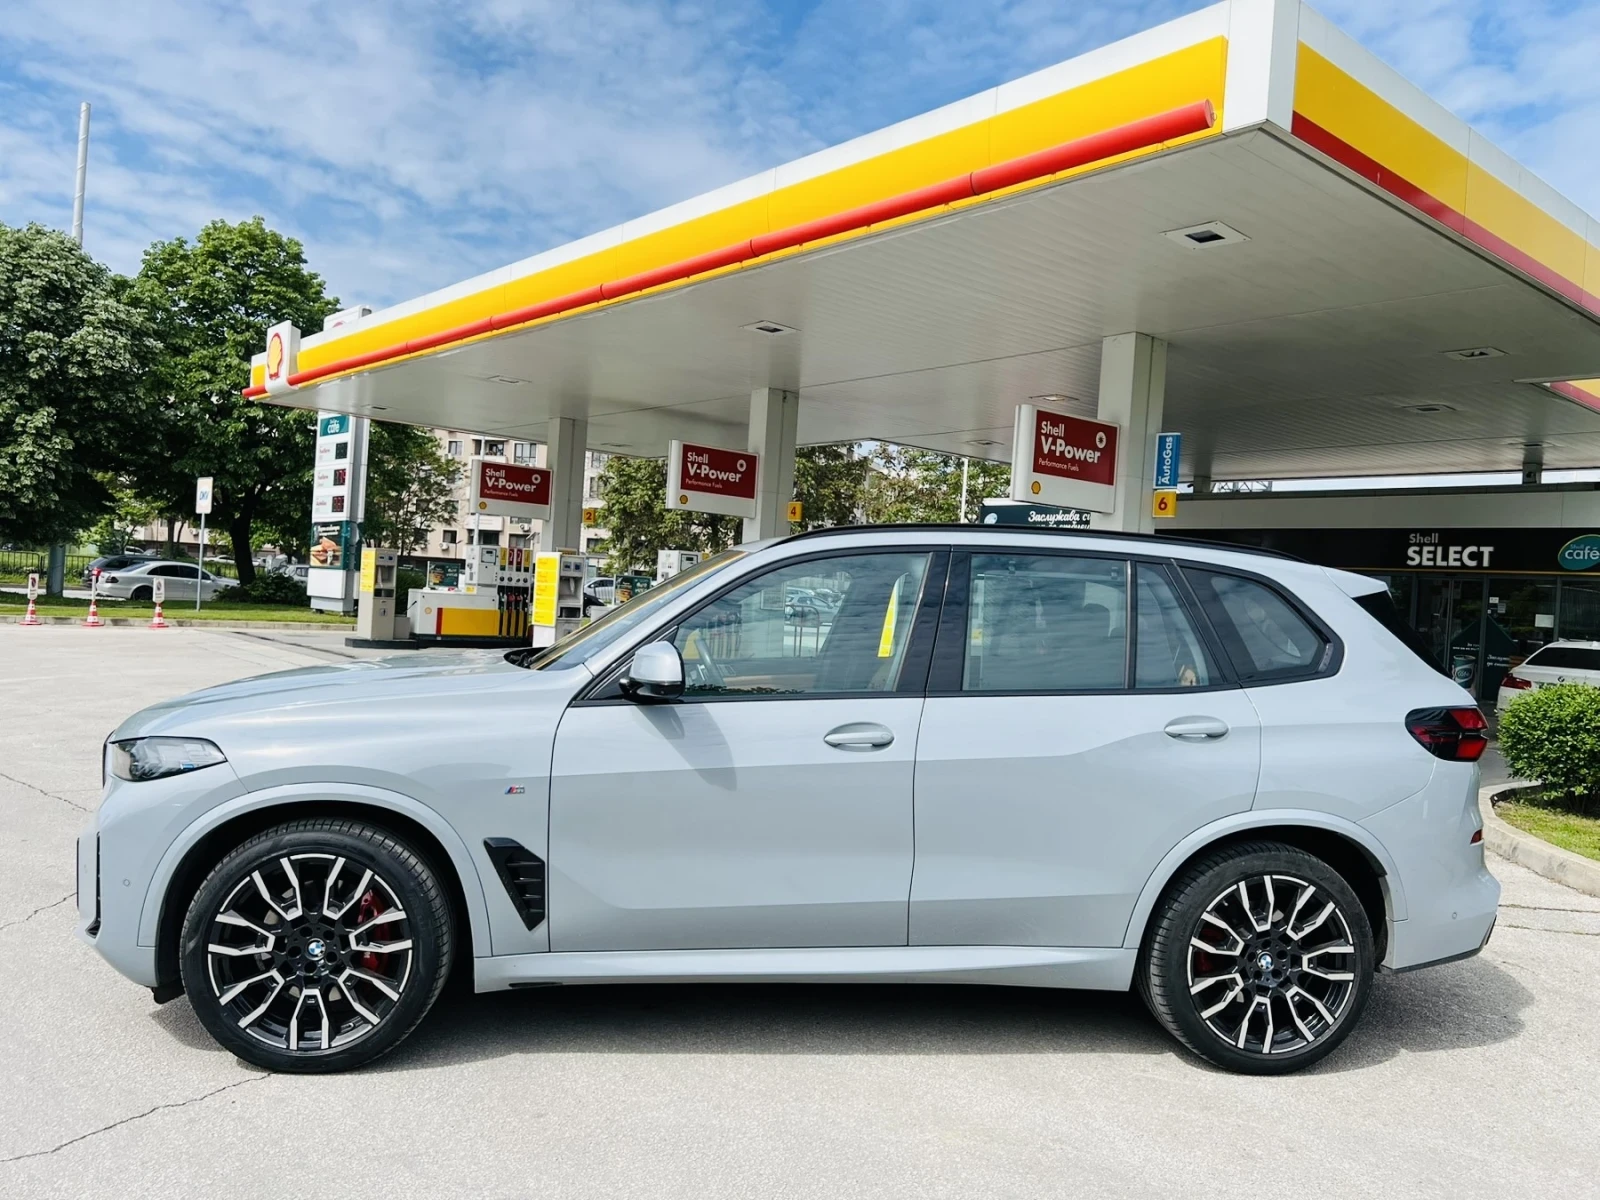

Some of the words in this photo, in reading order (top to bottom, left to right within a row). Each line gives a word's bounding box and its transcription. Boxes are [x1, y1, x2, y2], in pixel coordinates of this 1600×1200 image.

[1041, 421, 1065, 437] Shell
[1041, 435, 1101, 463] V-Power
[687, 452, 709, 464] Shell
[1038, 457, 1067, 470] Performance
[1068, 462, 1080, 472] Fuels
[1161, 436, 1173, 485] AutoGas
[485, 467, 506, 478] Shell
[687, 462, 742, 482] V-Power
[485, 476, 537, 492] V-Power
[685, 478, 711, 488] Performance
[790, 506, 796, 516] 4
[1158, 497, 1168, 511] 6
[585, 511, 592, 520] 2
[1028, 510, 1080, 525] Заслужава
[1409, 533, 1439, 544] Shell
[1406, 546, 1495, 567] SELECT
[1565, 545, 1600, 560] café
